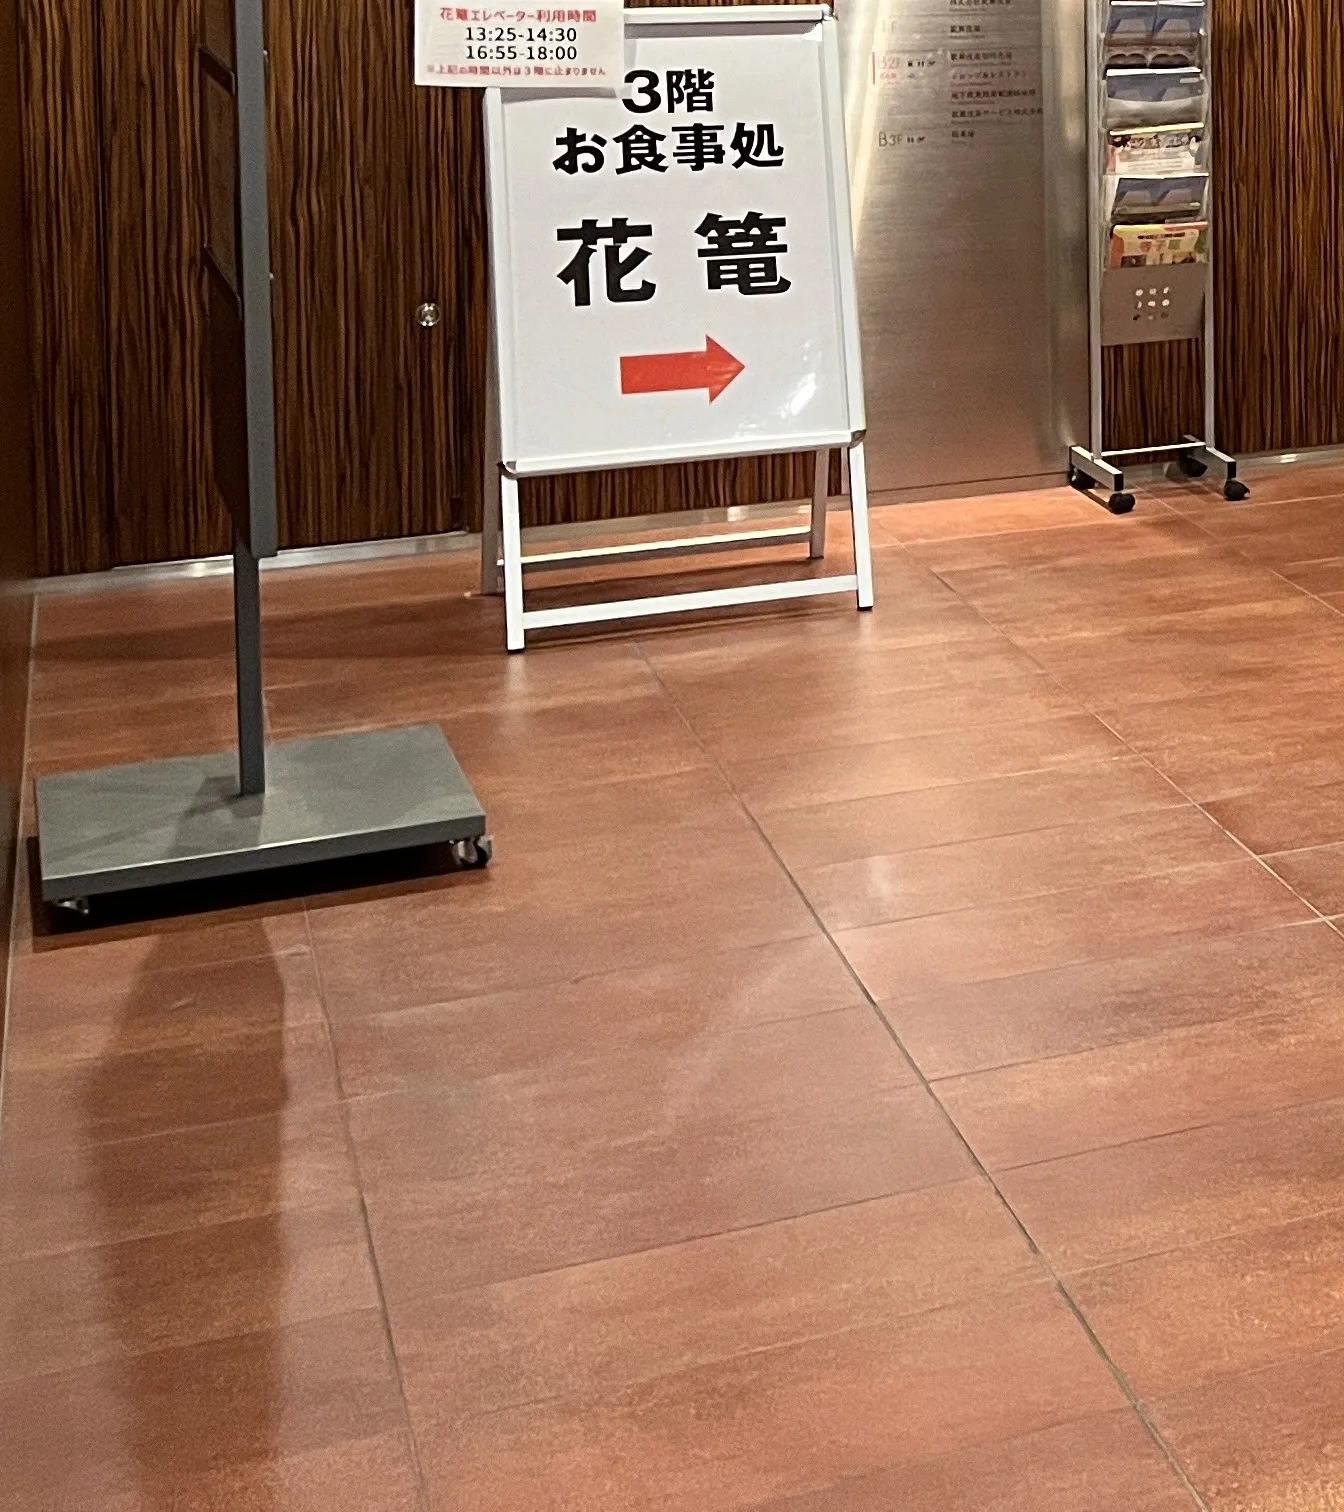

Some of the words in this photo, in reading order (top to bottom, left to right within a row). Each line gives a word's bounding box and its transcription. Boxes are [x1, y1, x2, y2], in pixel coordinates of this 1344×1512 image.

[465, 27, 577, 42] 13:25-14:30
[466, 45, 577, 60] 16:55-18:00
[621, 68, 715, 114] 3階
[552, 122, 785, 175] お食事処
